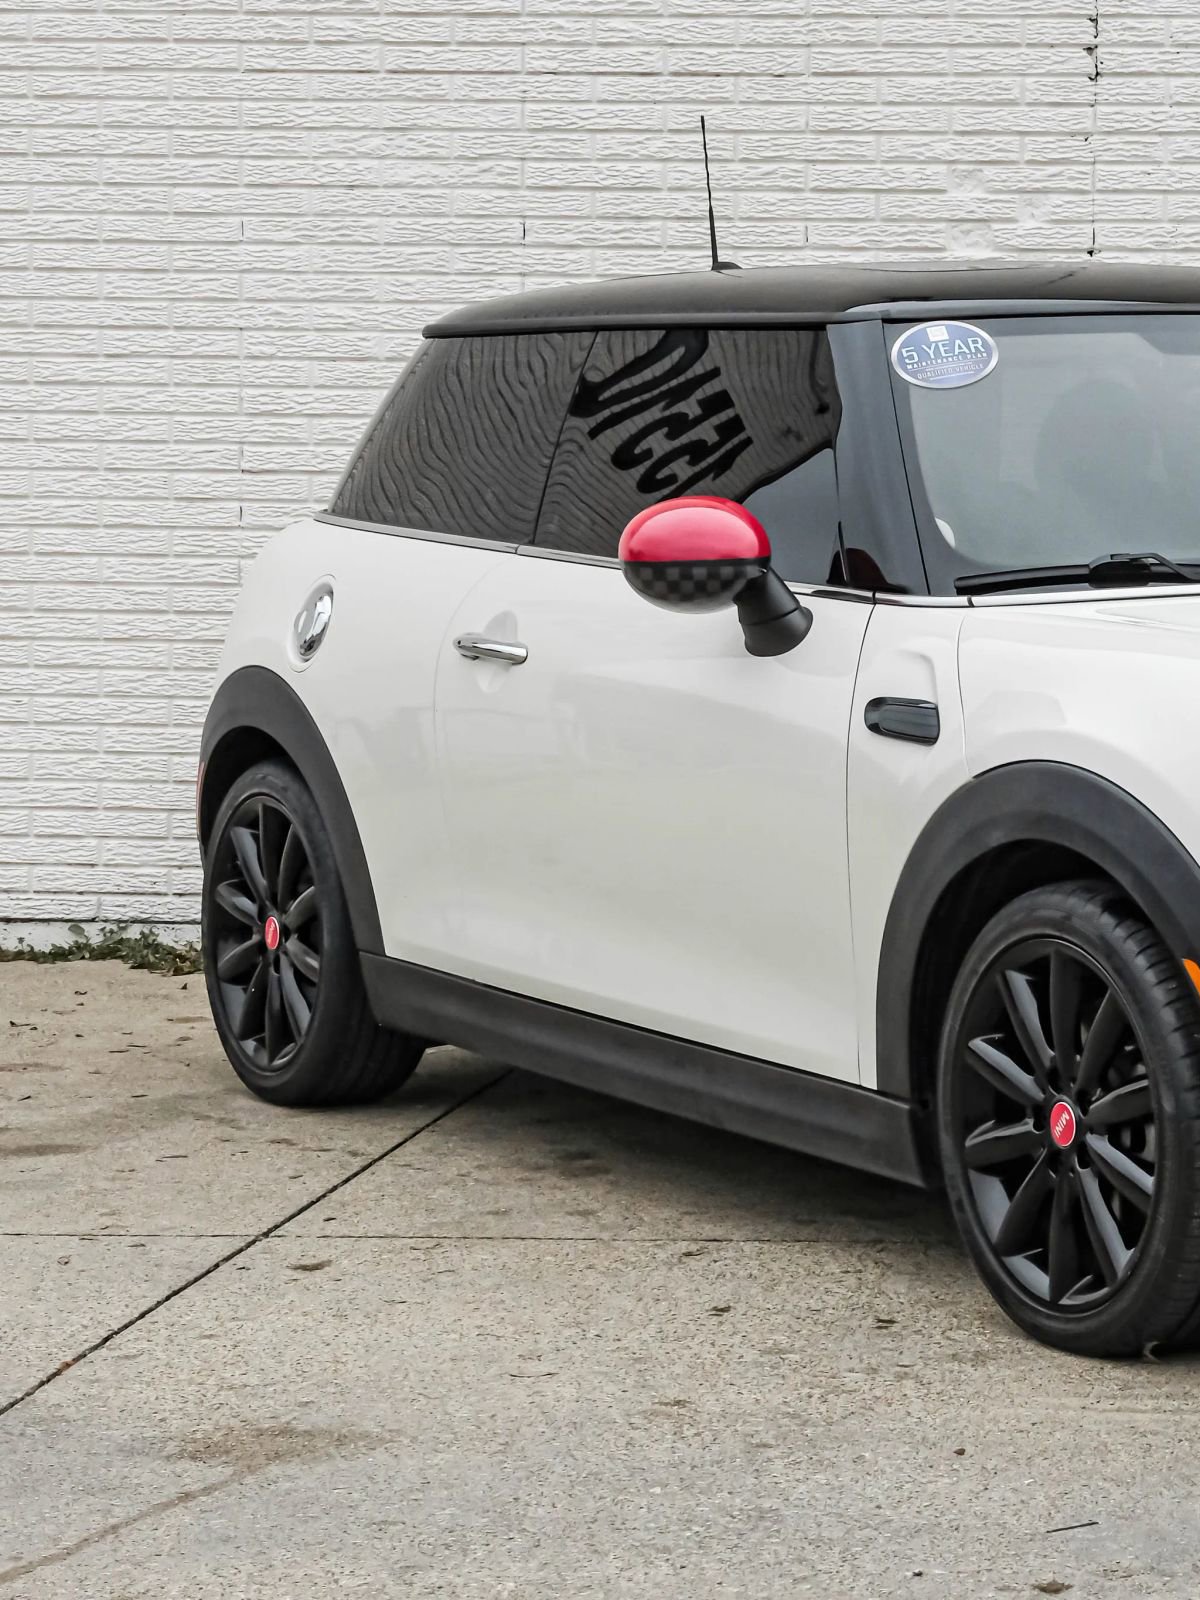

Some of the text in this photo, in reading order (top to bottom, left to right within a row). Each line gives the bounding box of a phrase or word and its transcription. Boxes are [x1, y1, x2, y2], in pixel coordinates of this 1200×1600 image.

[901, 337, 986, 364] 5 YEAR
[906, 355, 963, 370] MAINTENANCE
[967, 352, 988, 360] PLAN
[917, 368, 953, 380] QUALIFIED
[955, 363, 985, 373] VEHICLE
[1054, 1110, 1070, 1138] MINI
